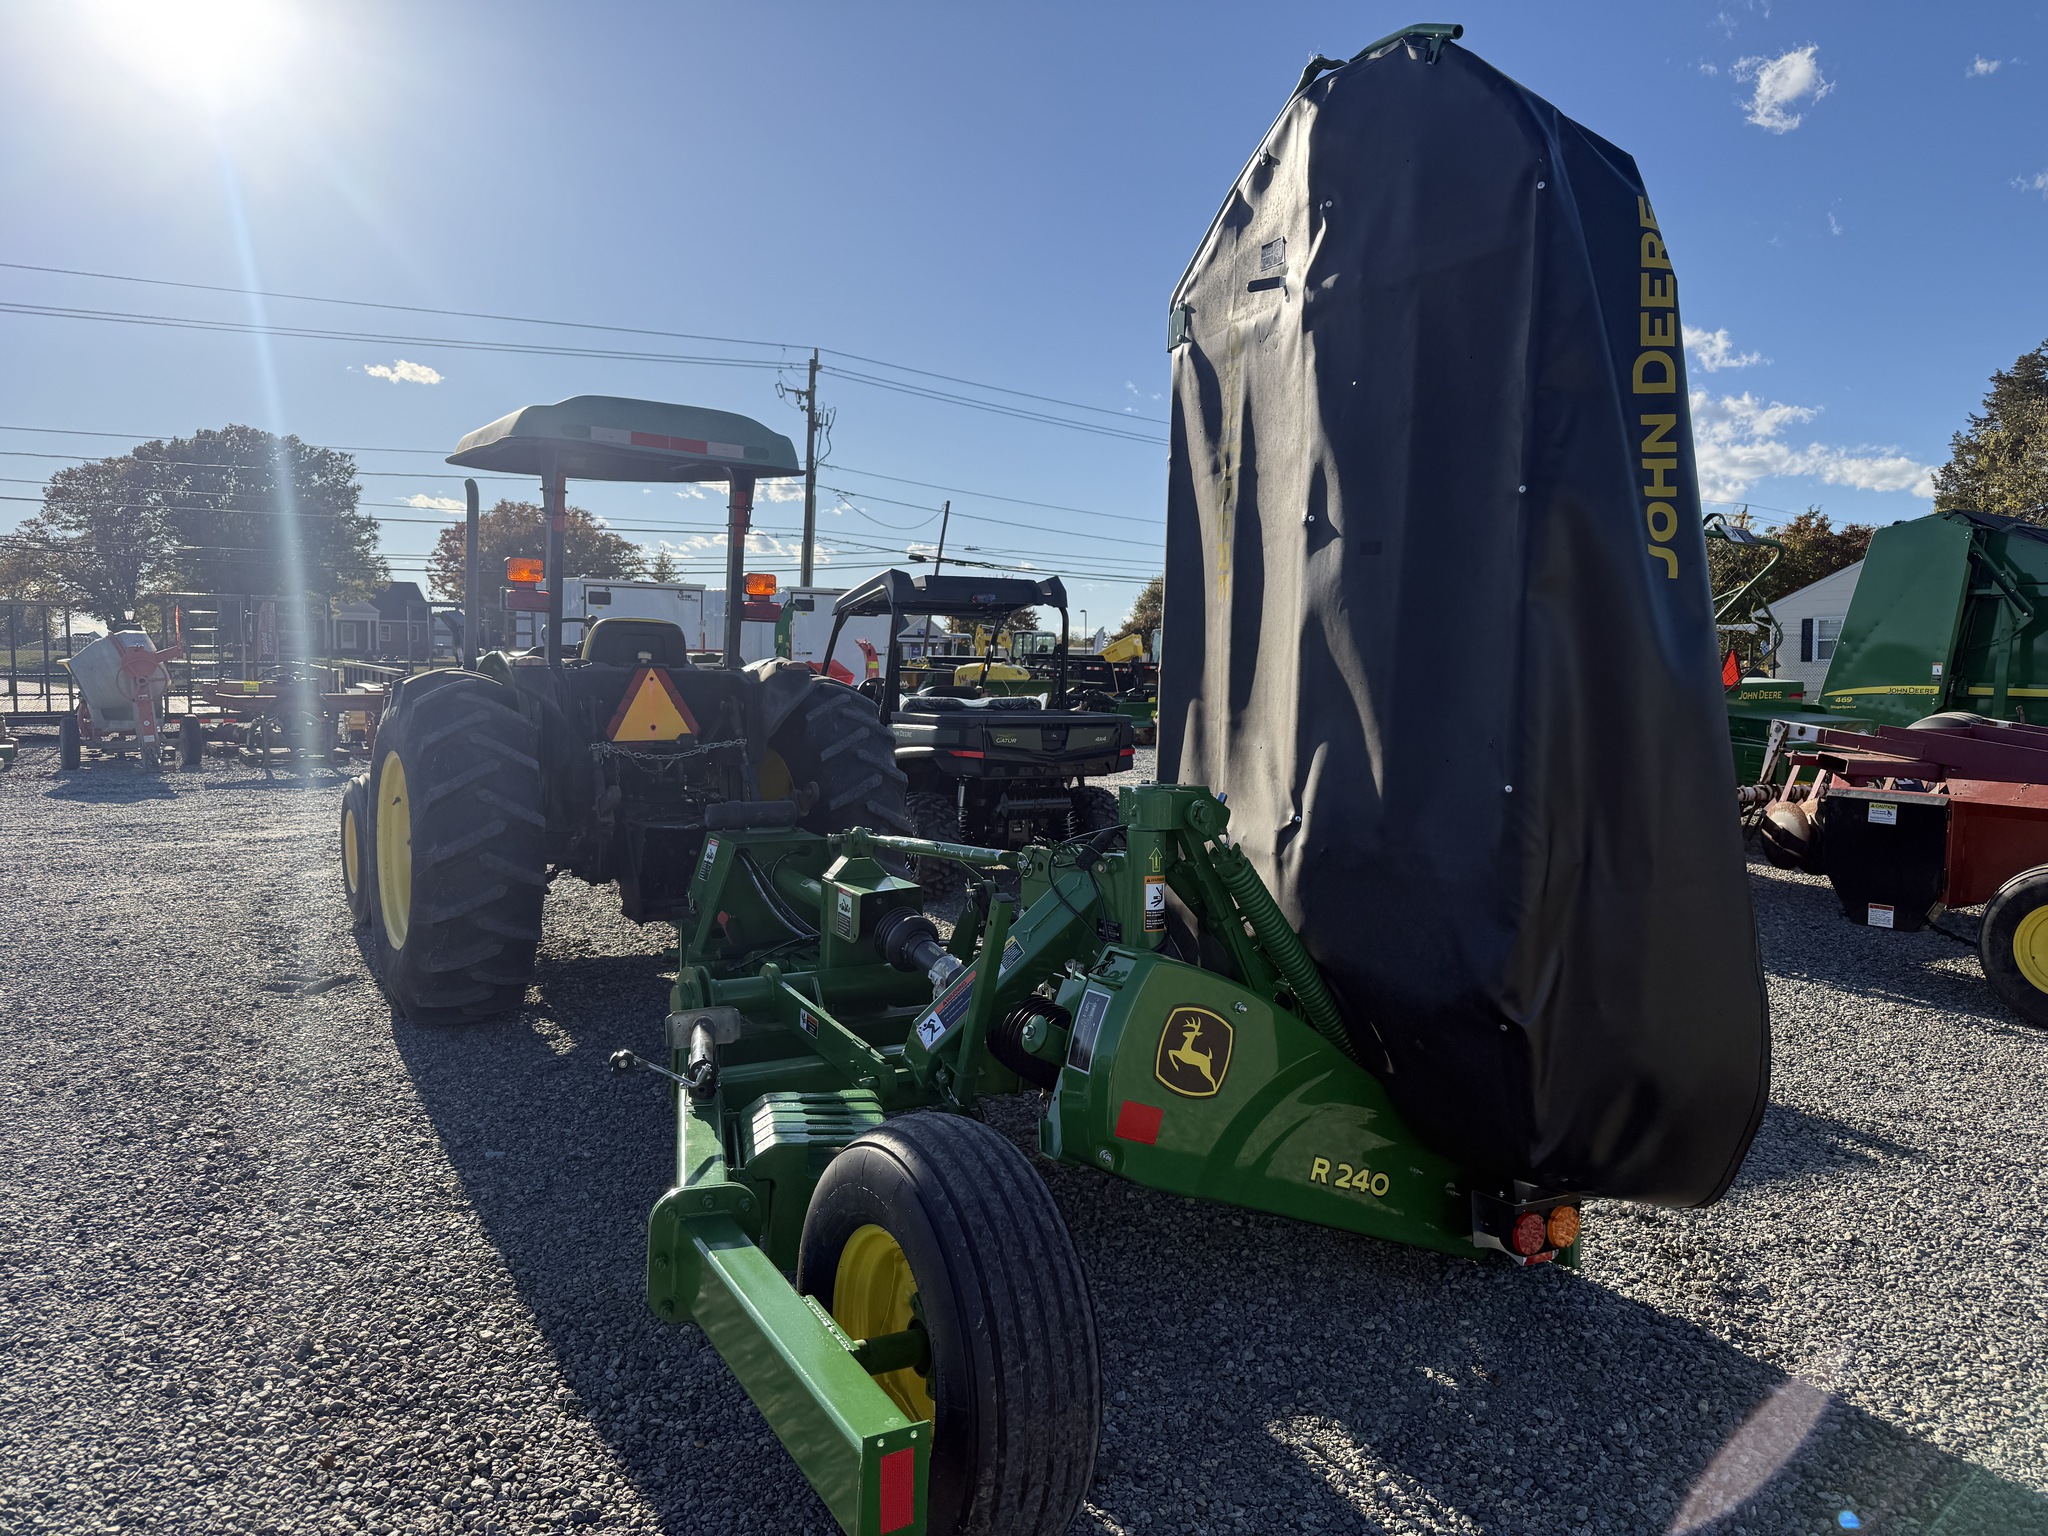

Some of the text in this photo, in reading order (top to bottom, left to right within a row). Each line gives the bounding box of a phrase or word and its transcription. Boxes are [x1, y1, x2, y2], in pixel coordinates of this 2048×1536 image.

[1640, 413, 1679, 580] JOHN
[1738, 689, 1783, 700] JOHN DEERE
[1908, 686, 1936, 694] DEERE
[1310, 1156, 1391, 1198] R 240
